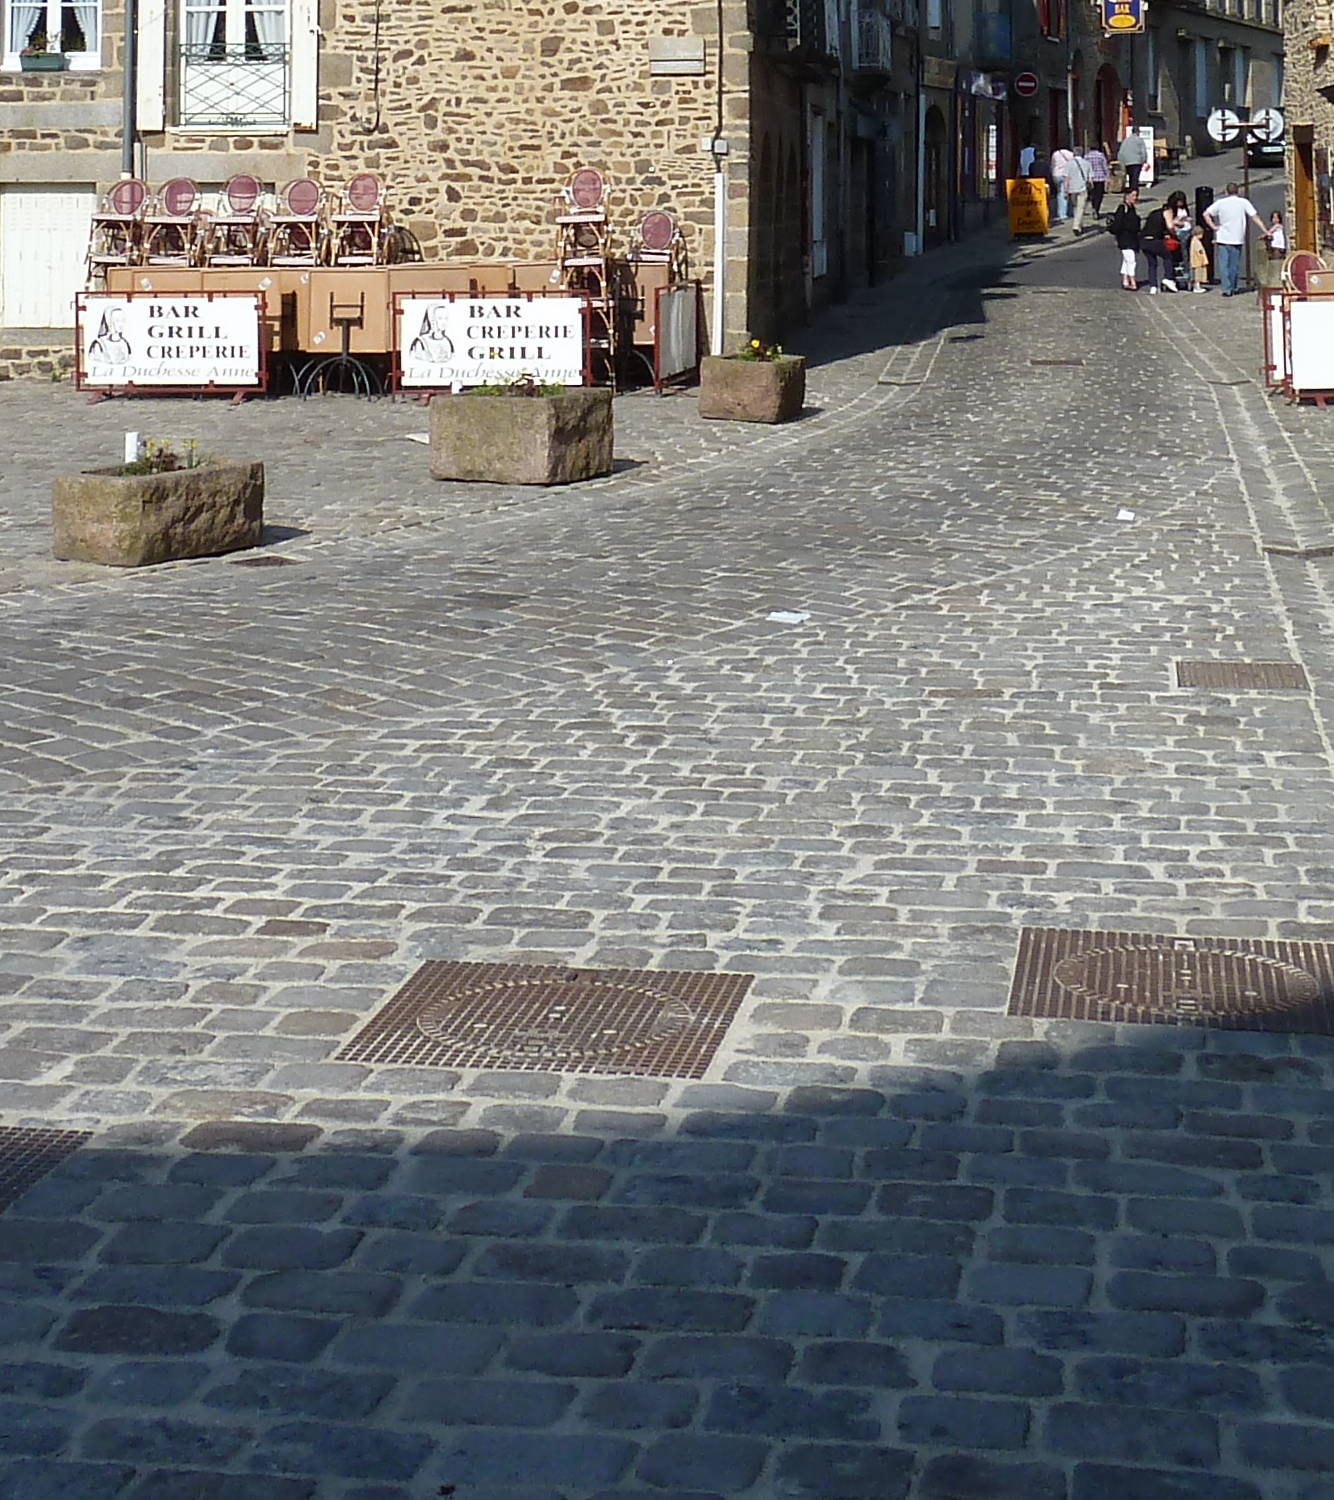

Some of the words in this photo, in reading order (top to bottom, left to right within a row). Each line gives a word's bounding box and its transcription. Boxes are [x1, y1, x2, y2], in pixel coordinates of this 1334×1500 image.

[149, 305, 200, 318] BAR
[469, 305, 522, 318] BAR
[147, 325, 228, 339] GRILL
[466, 325, 575, 339] CREPERIE
[146, 345, 251, 359] CREPERIE
[467, 346, 551, 360] GRILL
[92, 366, 114, 377] La
[122, 360, 200, 378] Duchesse
[207, 365, 255, 377] Anne
[409, 367, 431, 379] La
[439, 362, 521, 380] Duchesse
[531, 365, 578, 379] Anne
